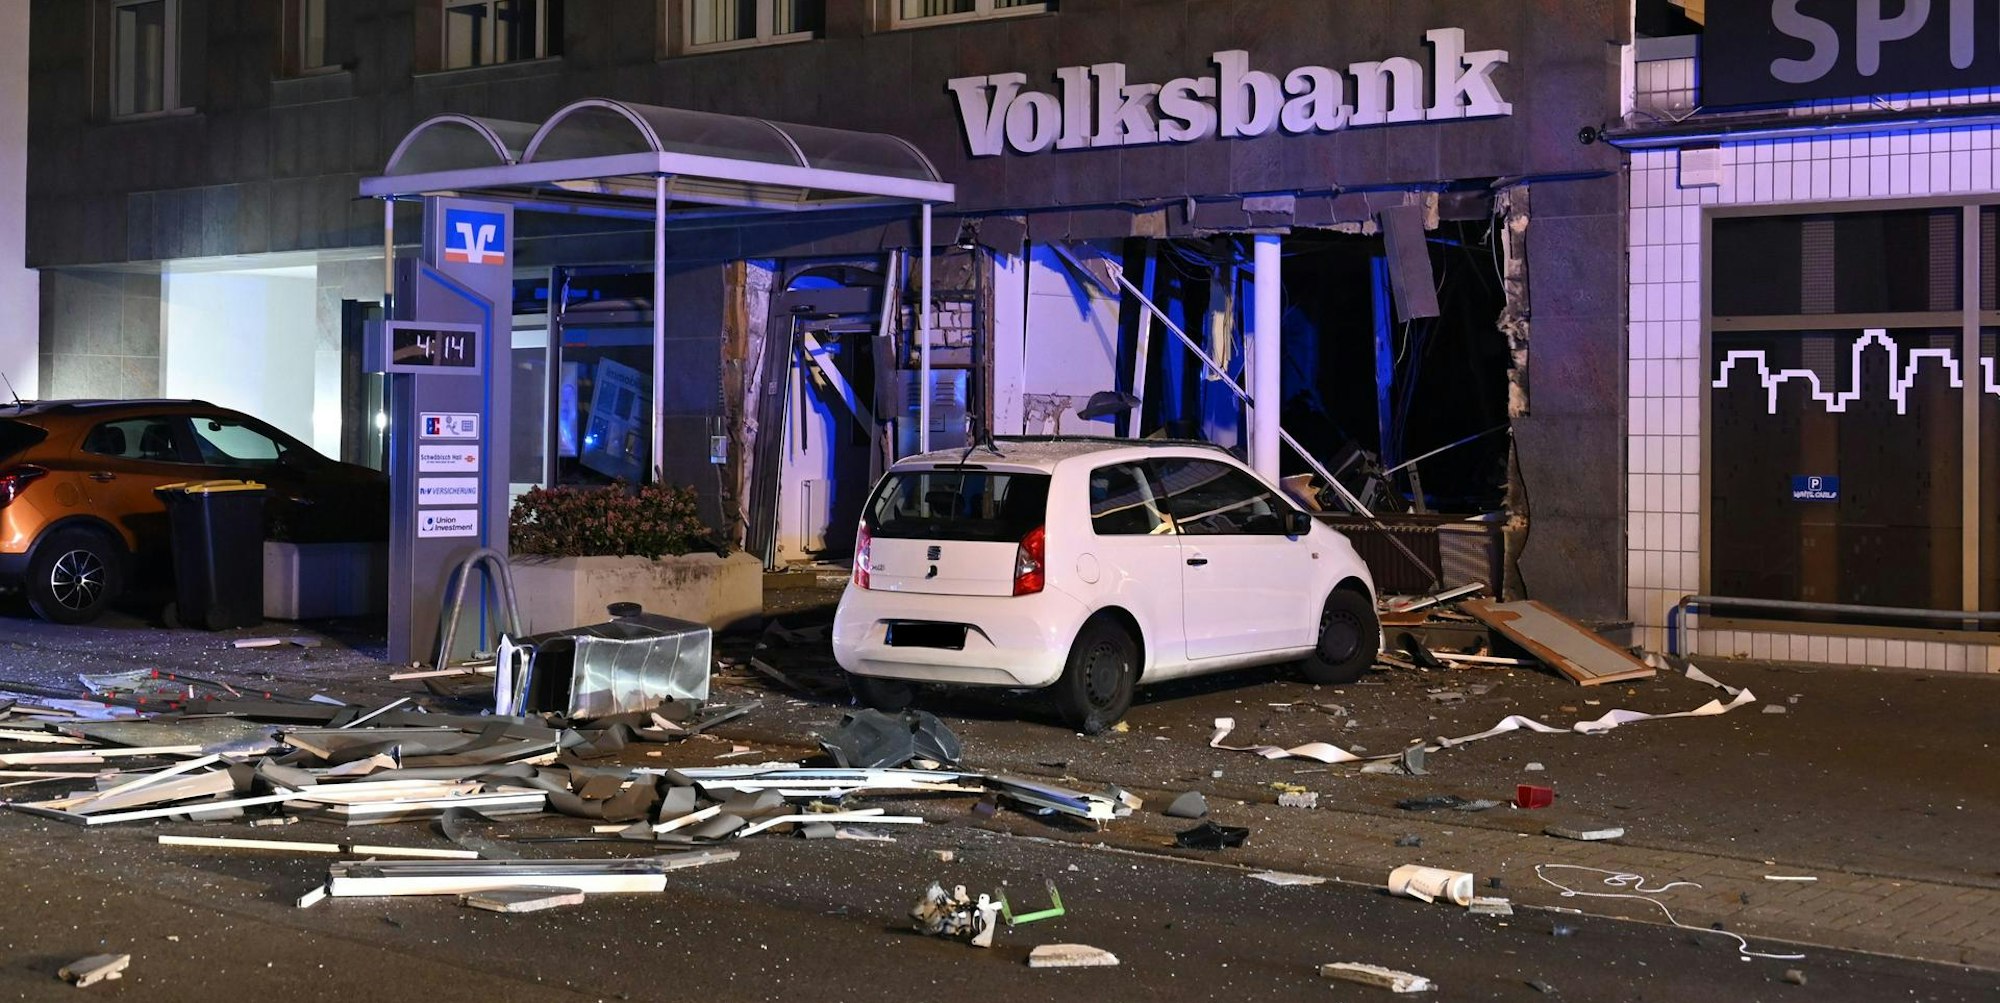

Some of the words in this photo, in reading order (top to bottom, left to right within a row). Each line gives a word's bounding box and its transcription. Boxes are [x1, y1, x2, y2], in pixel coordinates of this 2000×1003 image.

[947, 27, 1513, 157] Volksbank
[417, 335, 464, 359] 4:14
[432, 487, 476, 495] VERSICHERUNG
[436, 516, 456, 524] Union
[434, 523, 473, 531] Investment
